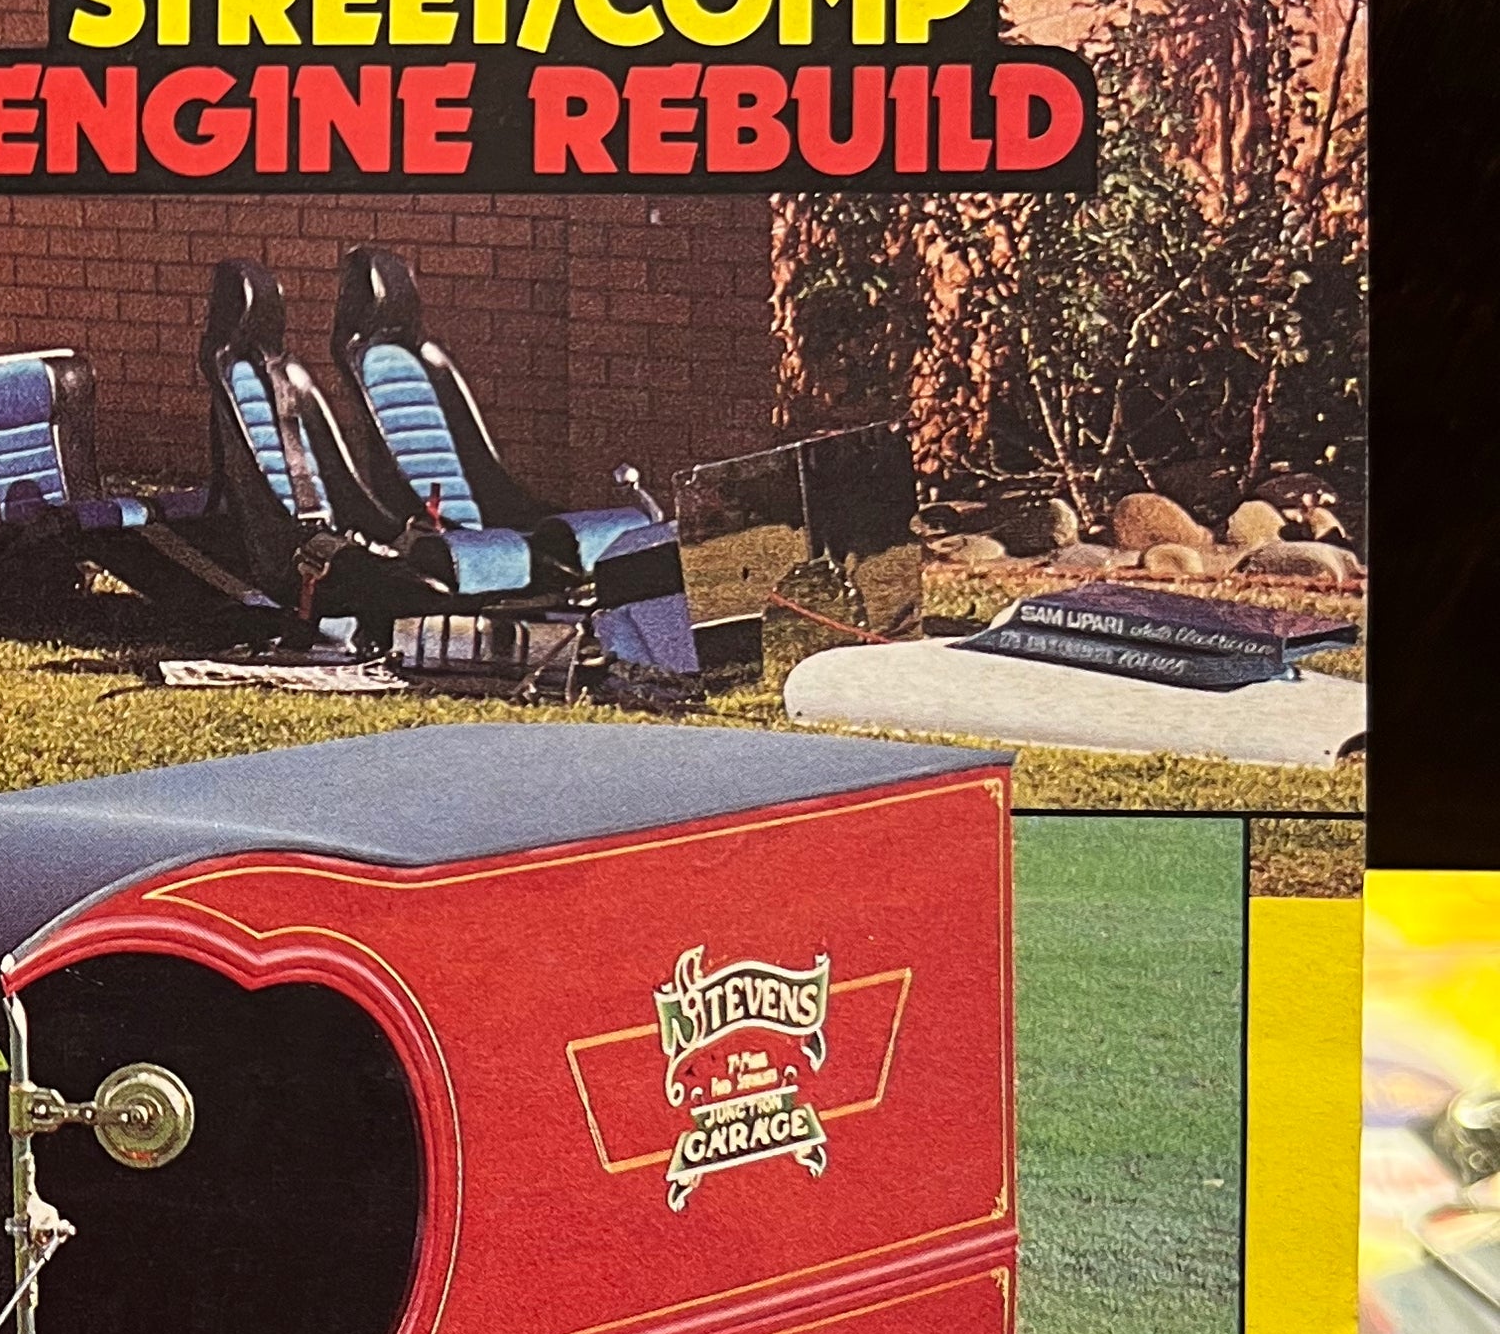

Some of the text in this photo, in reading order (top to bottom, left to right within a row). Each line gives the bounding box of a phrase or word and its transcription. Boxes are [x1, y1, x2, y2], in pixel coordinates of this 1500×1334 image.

[529, 60, 1086, 176] REBUILD
[1020, 605, 1063, 626] SAM
[672, 945, 820, 1051] STEVENS
[682, 1109, 810, 1164] GARAGE
